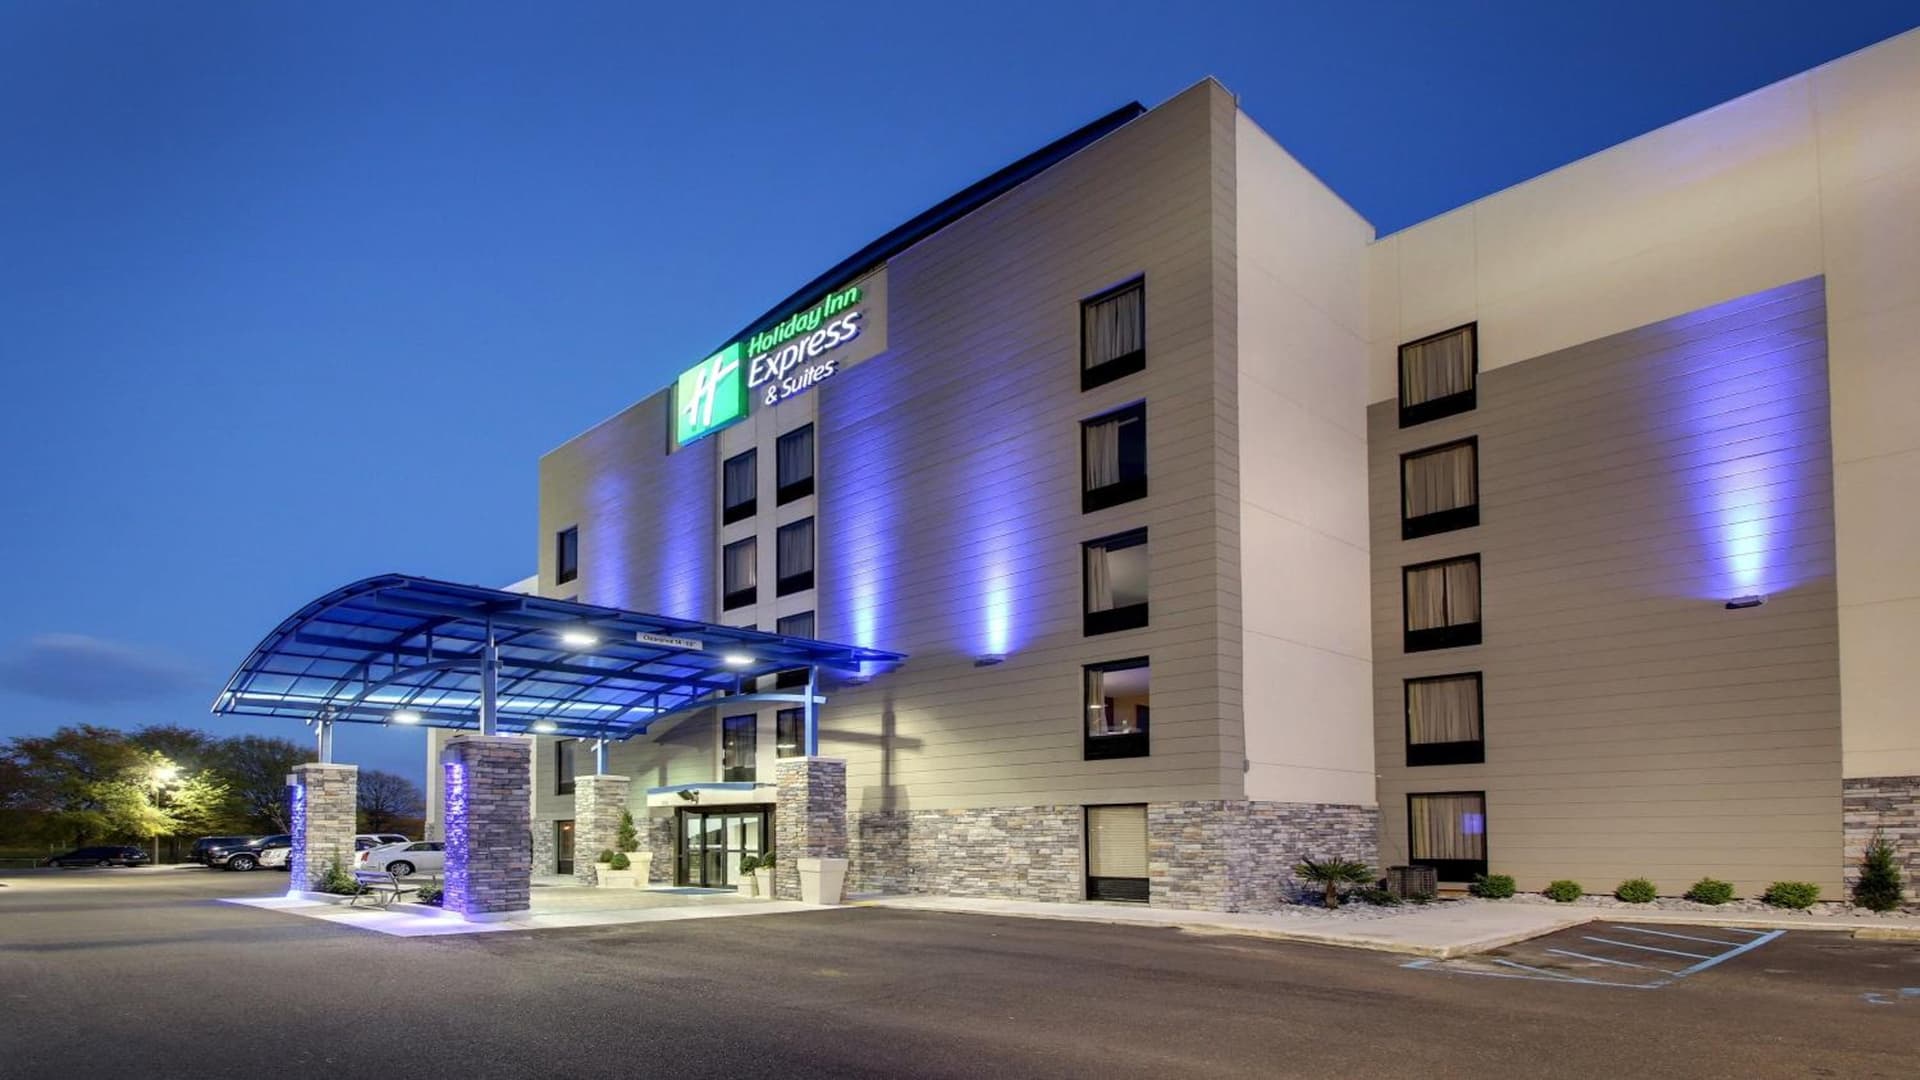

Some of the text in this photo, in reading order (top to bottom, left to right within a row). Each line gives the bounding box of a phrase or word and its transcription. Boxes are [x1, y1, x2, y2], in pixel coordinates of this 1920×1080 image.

[748, 287, 858, 357] Holiday Inn
[748, 312, 859, 388] Express
[764, 360, 836, 405] & Suites
